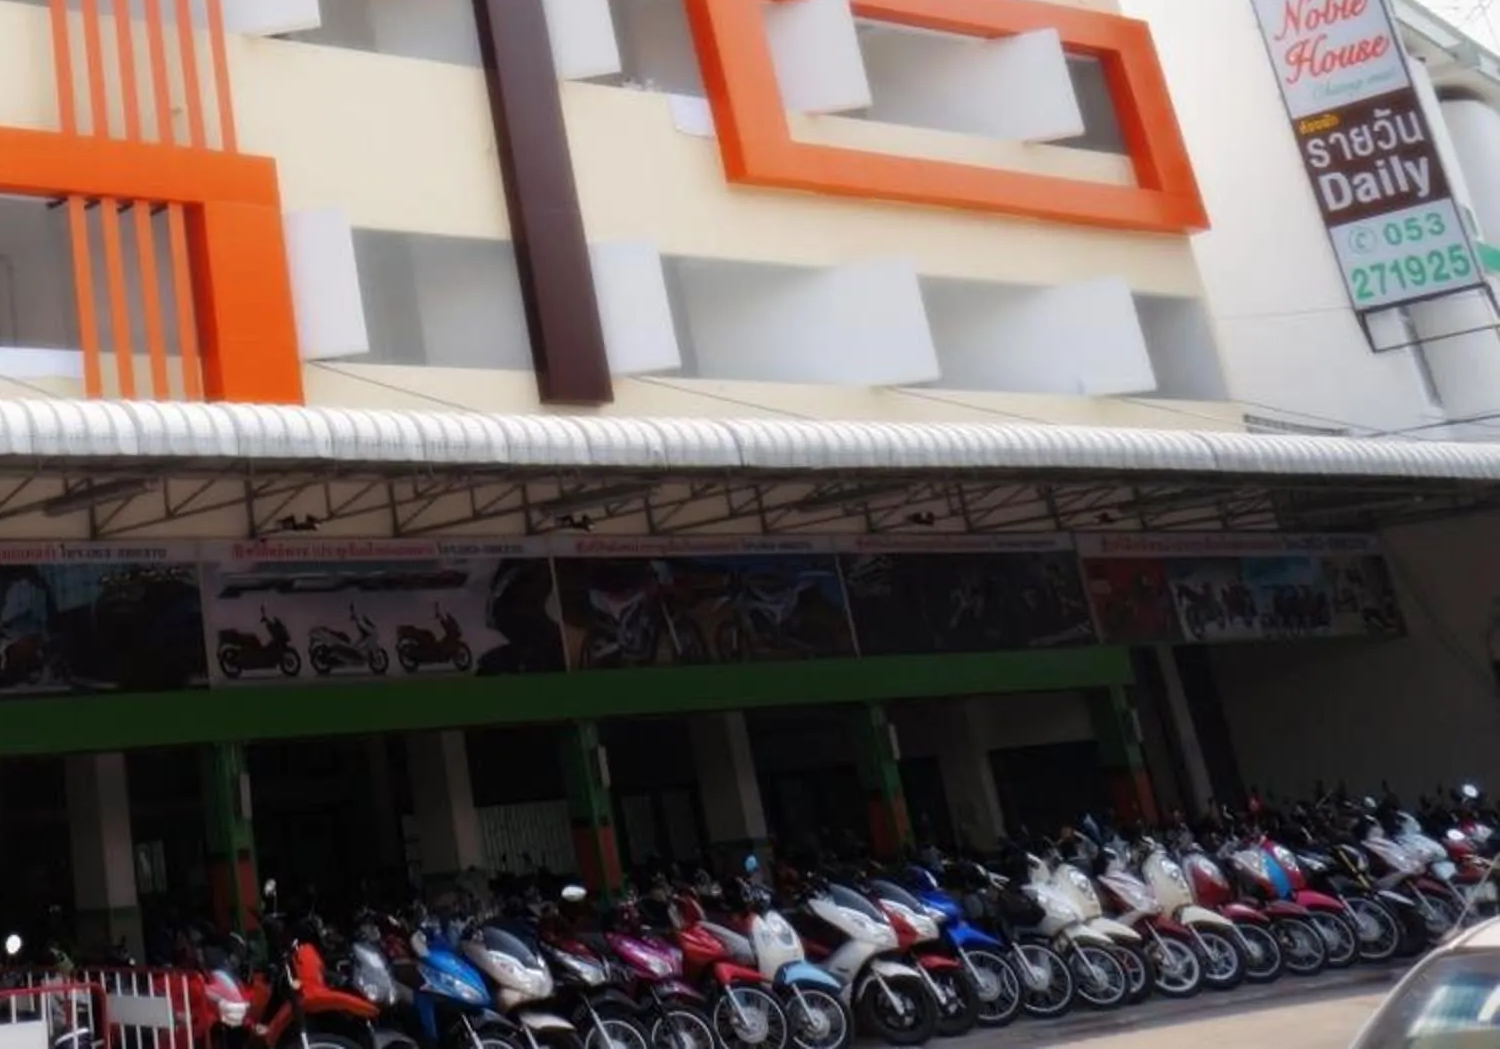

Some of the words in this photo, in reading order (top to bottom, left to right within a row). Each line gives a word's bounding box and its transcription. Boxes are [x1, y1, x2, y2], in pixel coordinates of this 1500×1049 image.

[1284, 29, 1390, 84] House
[1306, 108, 1425, 169] รายวัน
[1317, 155, 1432, 213] Daily
[1383, 212, 1446, 247] 053
[1351, 243, 1472, 301] 271925
